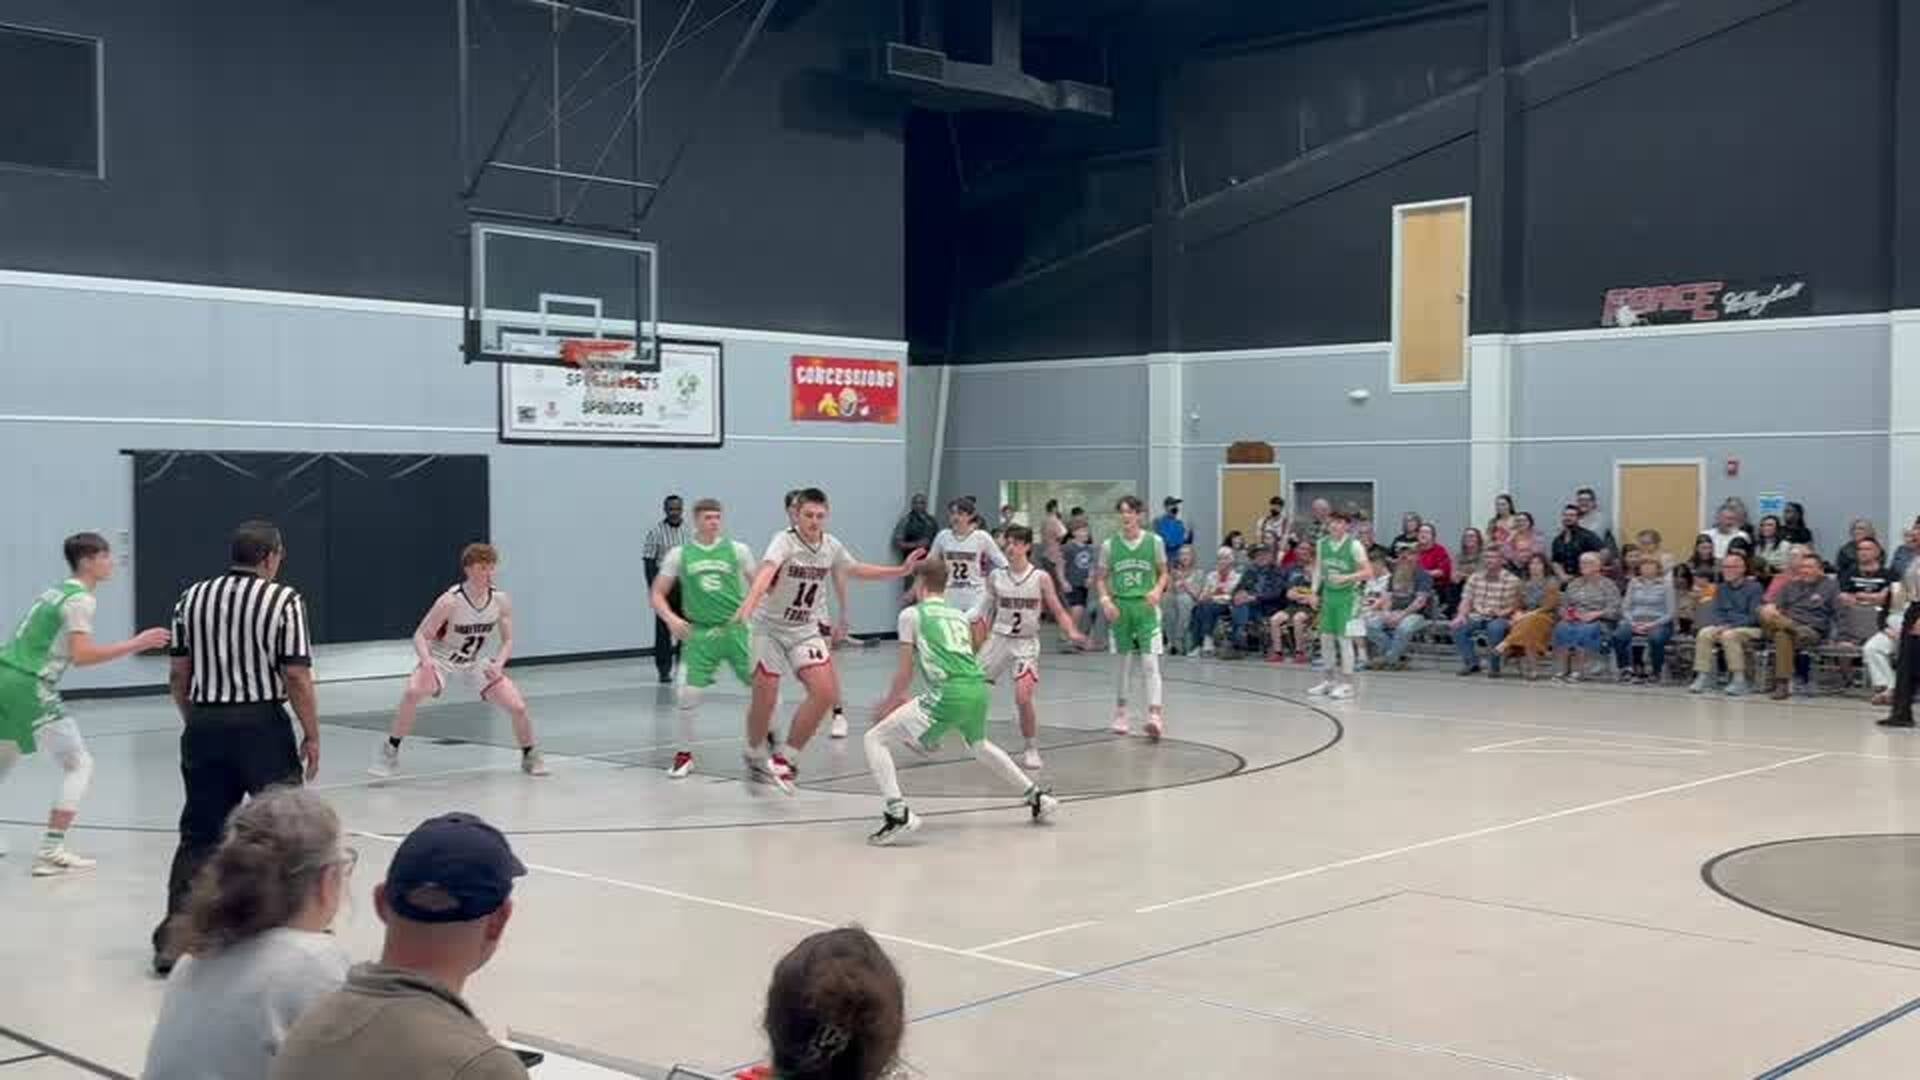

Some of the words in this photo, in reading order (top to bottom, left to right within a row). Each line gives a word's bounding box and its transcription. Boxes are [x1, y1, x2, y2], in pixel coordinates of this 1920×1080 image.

[1601, 281, 1725, 326] FORCE
[796, 365, 896, 388] CONCESSIONS
[952, 562, 969, 580] 22
[792, 582, 818, 608] 14
[1011, 612, 1022, 634] 2
[461, 635, 485, 657] 21
